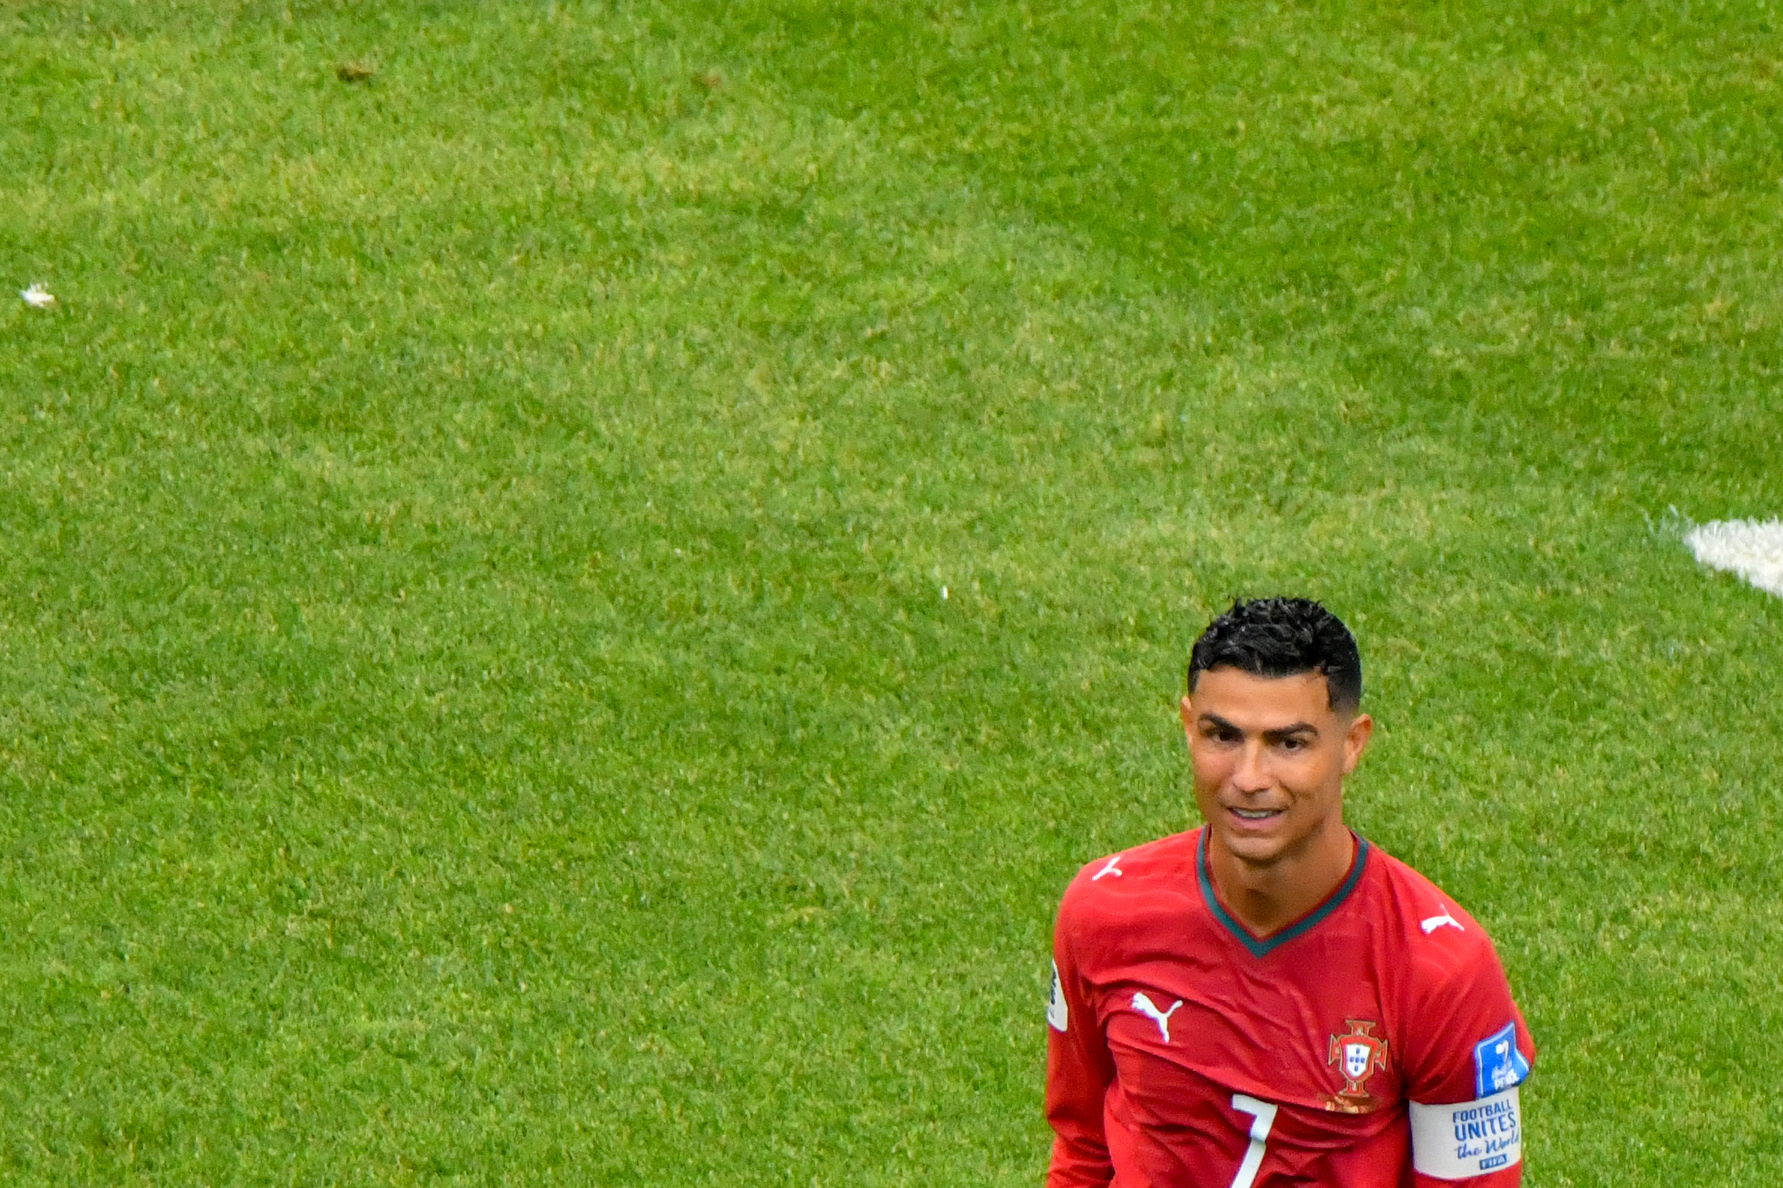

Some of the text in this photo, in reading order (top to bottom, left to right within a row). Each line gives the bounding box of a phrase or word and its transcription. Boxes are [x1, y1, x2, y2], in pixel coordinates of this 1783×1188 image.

[1452, 1099, 1513, 1124] FOOTBALL
[1454, 1111, 1517, 1141] UNITES
[1455, 1144, 1483, 1160] the
